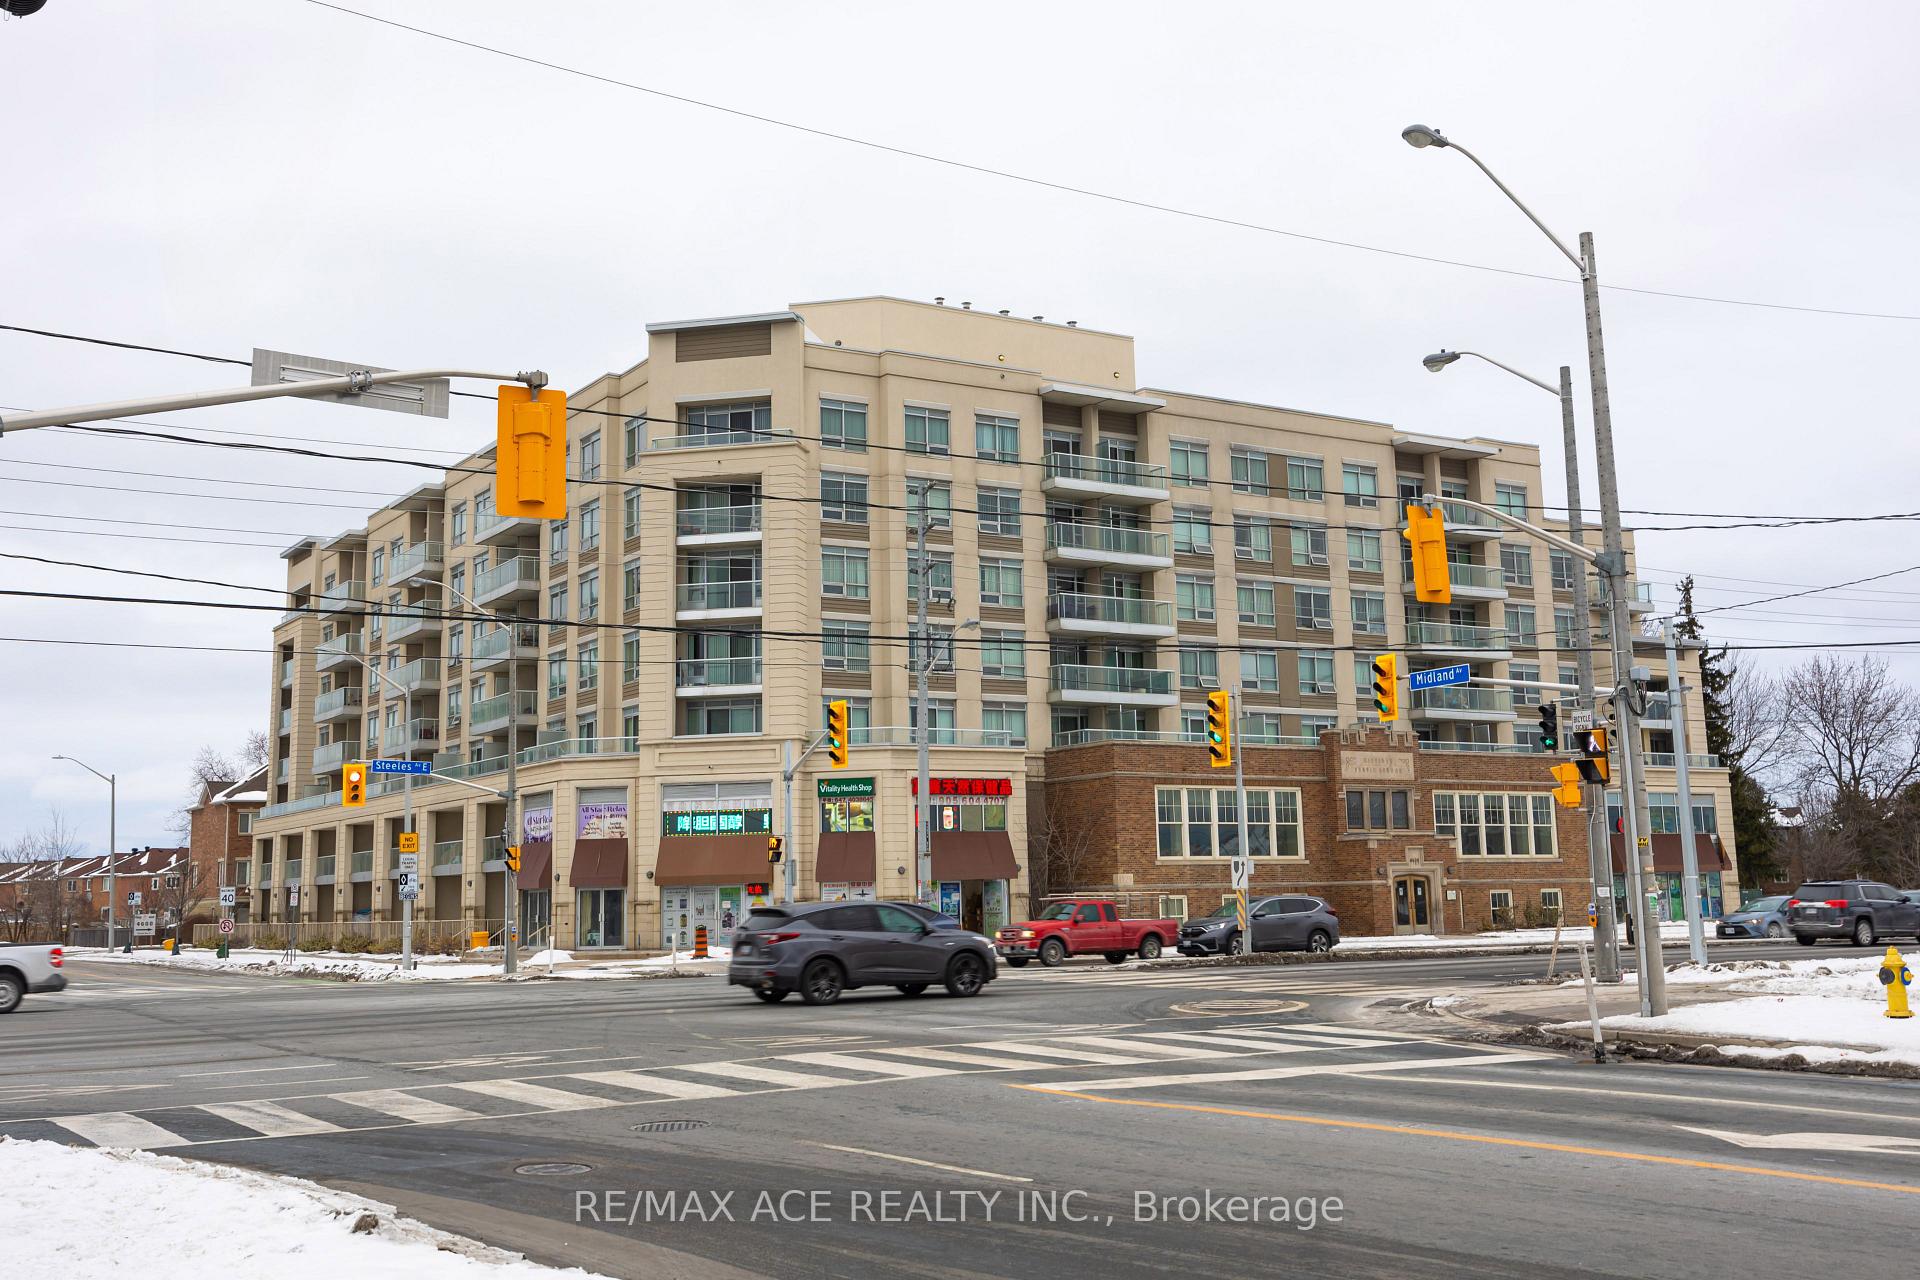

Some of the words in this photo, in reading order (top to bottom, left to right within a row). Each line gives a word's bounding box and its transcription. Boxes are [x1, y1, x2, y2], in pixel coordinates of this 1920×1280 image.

[1416, 668, 1455, 685] Midland
[1574, 714, 1591, 723] BICYCLE
[376, 761, 412, 771] Steeles
[422, 762, 428, 772] E
[820, 783, 841, 794] Vitality
[841, 784, 858, 792] Health
[858, 784, 872, 792] Shop
[938, 796, 958, 804] 905
[962, 796, 980, 804] 604
[984, 796, 1005, 804] 4707
[222, 894, 234, 902] 40
